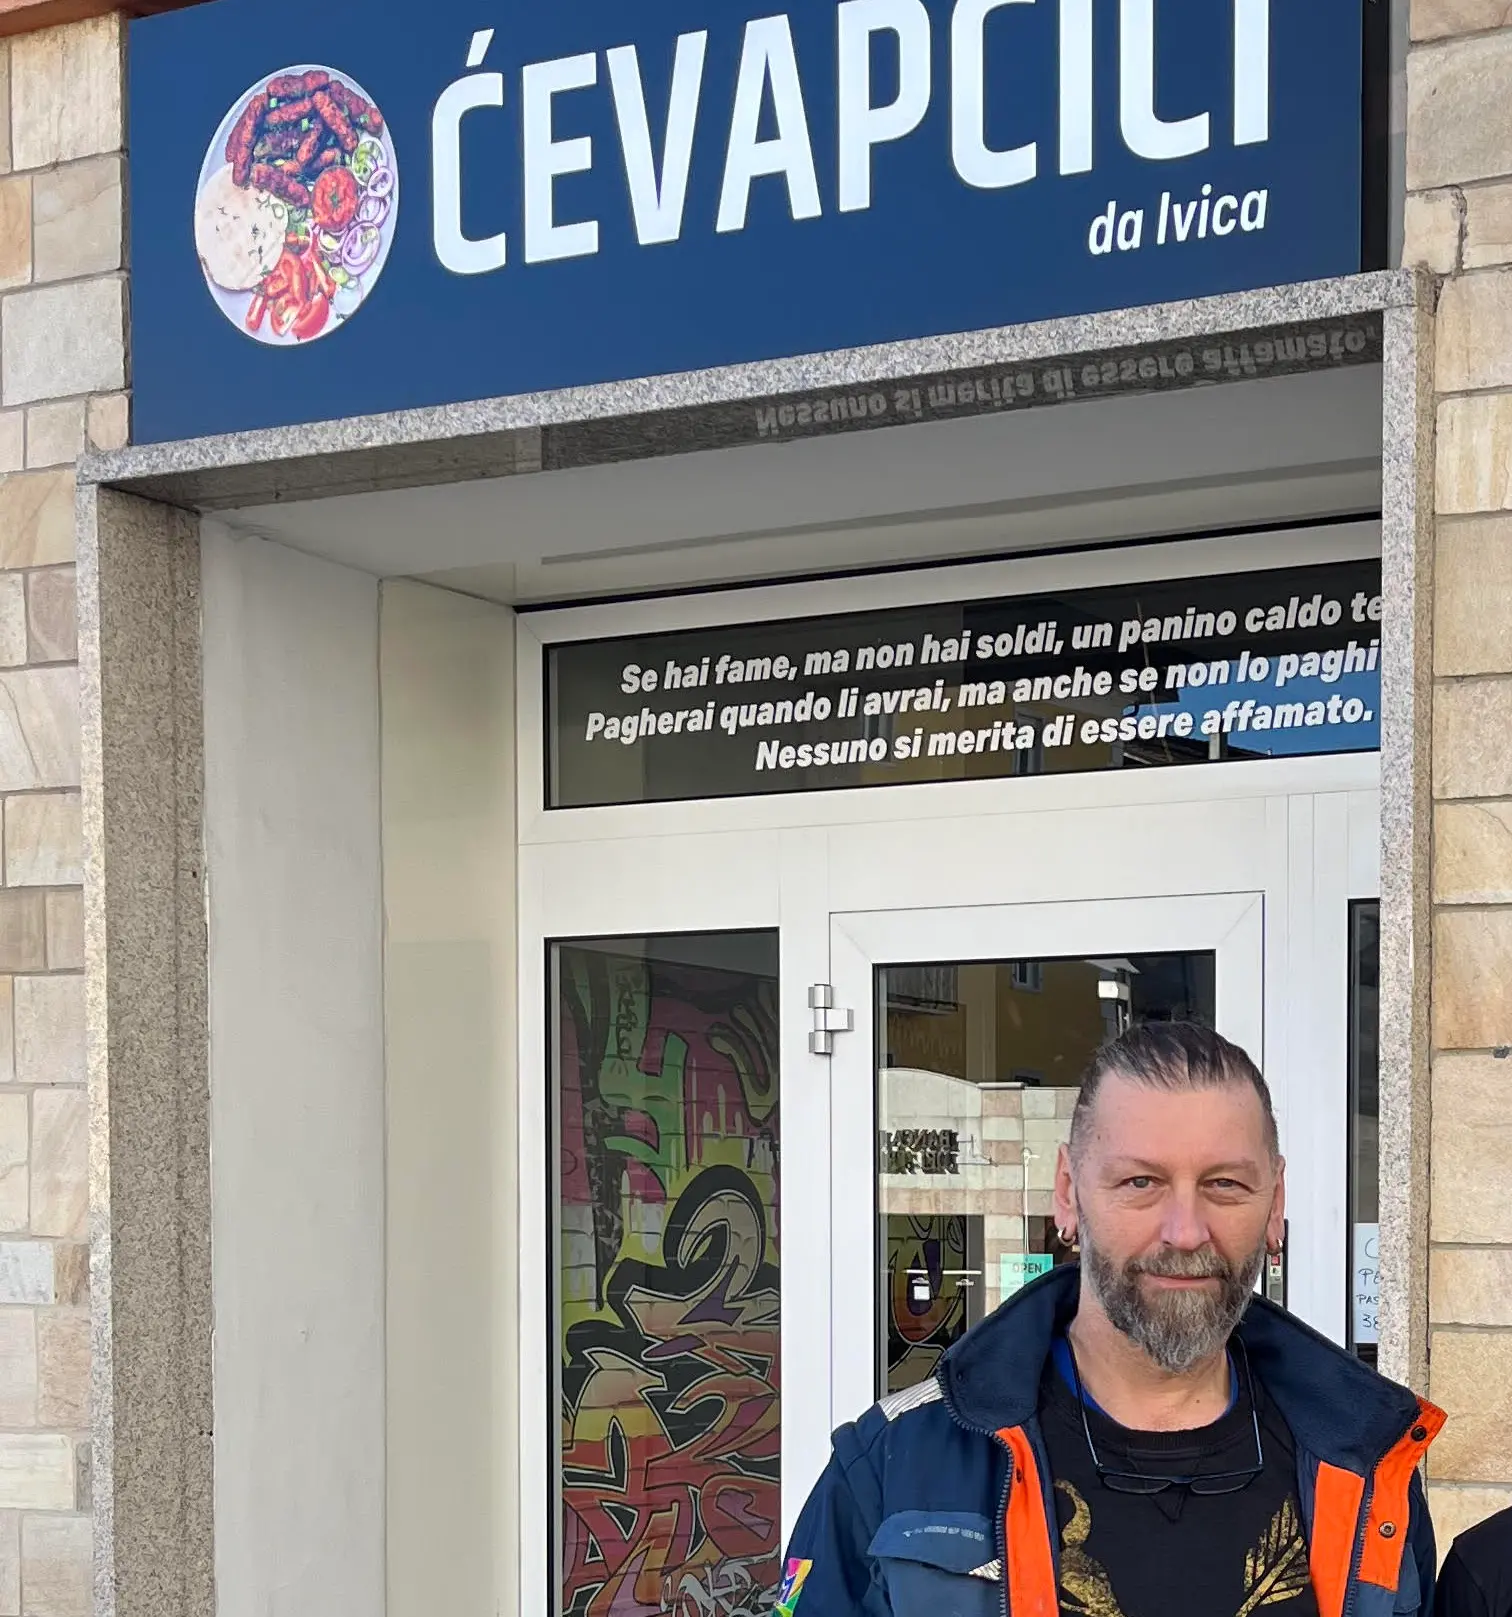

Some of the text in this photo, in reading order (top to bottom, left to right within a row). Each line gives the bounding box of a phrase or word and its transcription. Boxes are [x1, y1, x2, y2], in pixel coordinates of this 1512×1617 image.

[1088, 183, 1269, 255] da Ivica
[621, 664, 657, 694] Se
[664, 657, 709, 690] hai
[715, 653, 797, 684] fame,
[804, 649, 848, 676] ma
[856, 641, 914, 671] non
[920, 630, 970, 665] hai
[976, 621, 1064, 660] soldi,
[1071, 622, 1113, 650] un
[1118, 607, 1237, 653] panino
[1245, 595, 1342, 634] caldo
[585, 638, 1381, 745] Pagherai quando li avrai, ma anche se non lo paghi
[755, 694, 1374, 771] Nessuno si merita di essere affamato.
